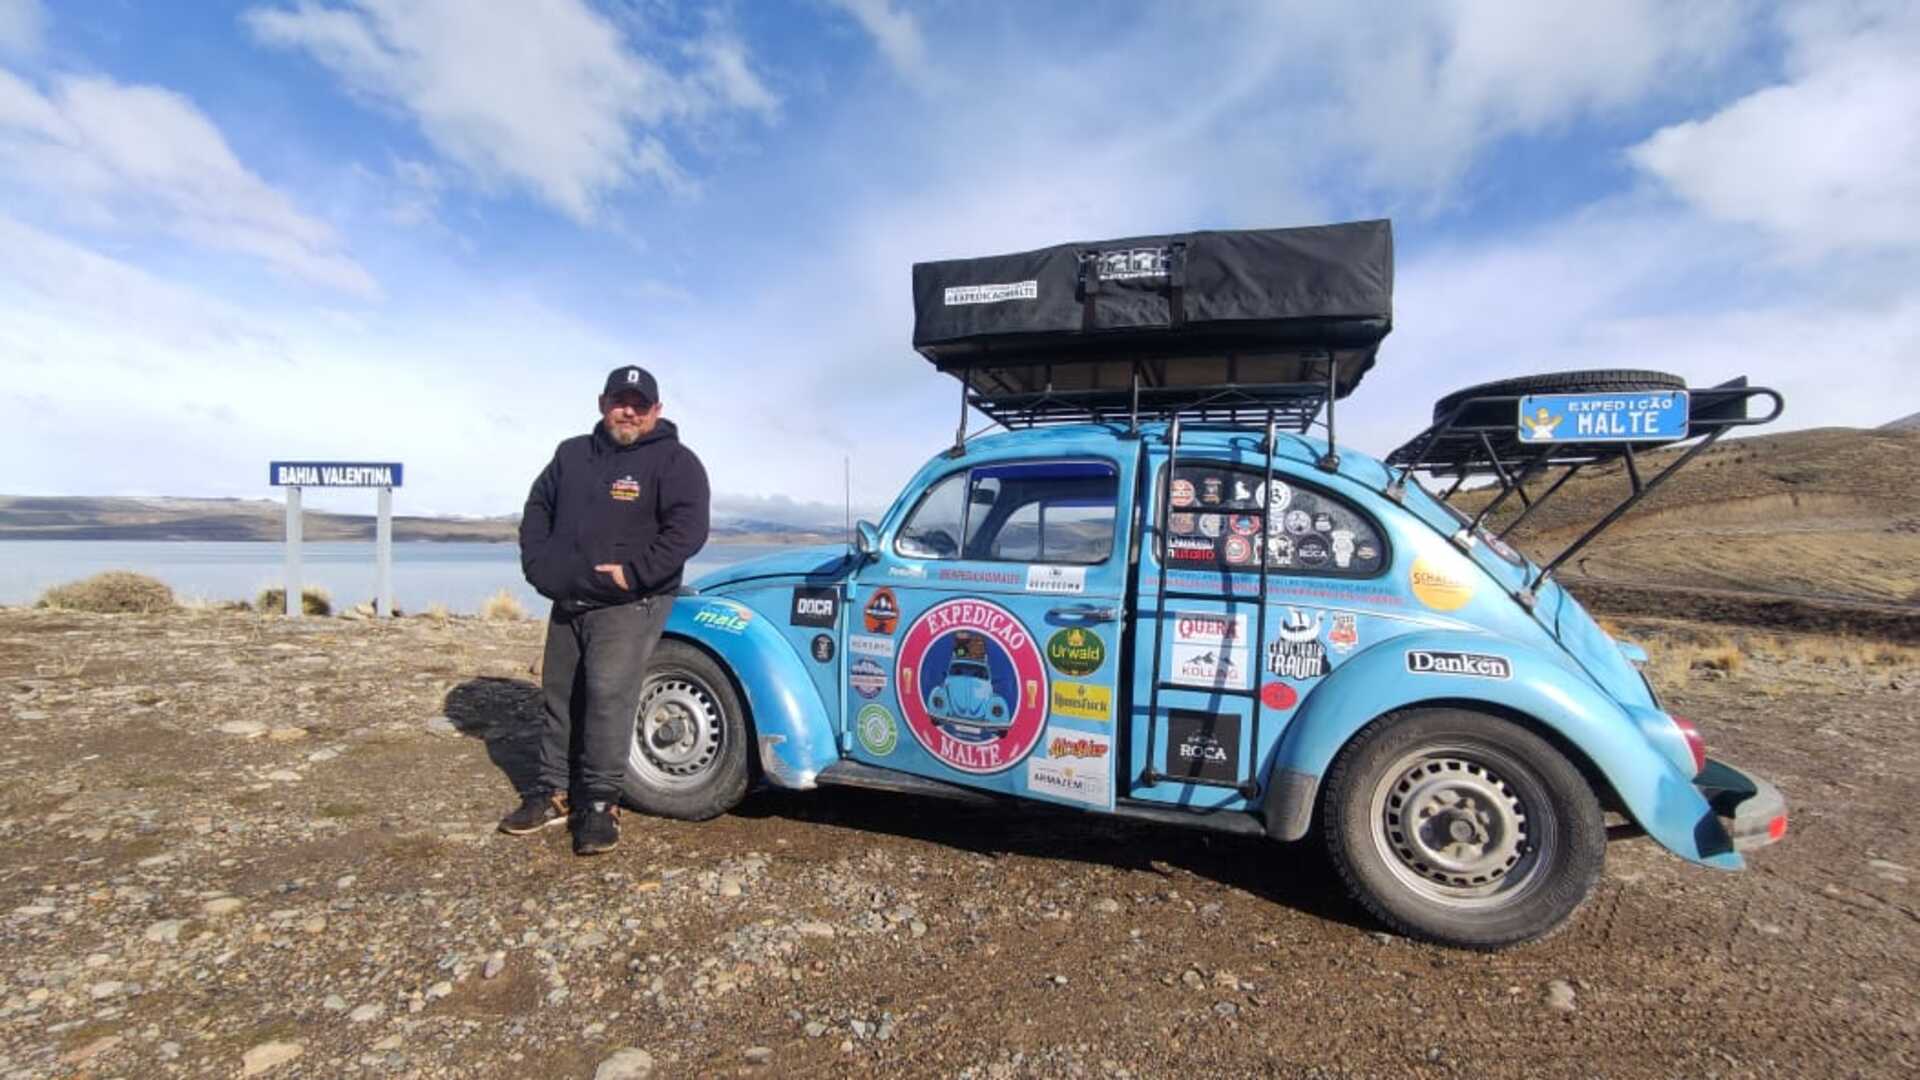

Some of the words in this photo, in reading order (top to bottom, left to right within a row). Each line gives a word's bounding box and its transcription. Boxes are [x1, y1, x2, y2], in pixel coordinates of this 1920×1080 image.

[1577, 411, 1659, 434] MALTE
[279, 466, 318, 485] BAHIA
[322, 466, 393, 486] VALENTINA
[797, 598, 834, 616] DOCA
[1052, 644, 1101, 661] Urwald
[1267, 653, 1322, 679] TRAUM
[1413, 652, 1505, 676] Danken
[939, 736, 1003, 771] MALTE
[1180, 744, 1227, 760] ROCA
